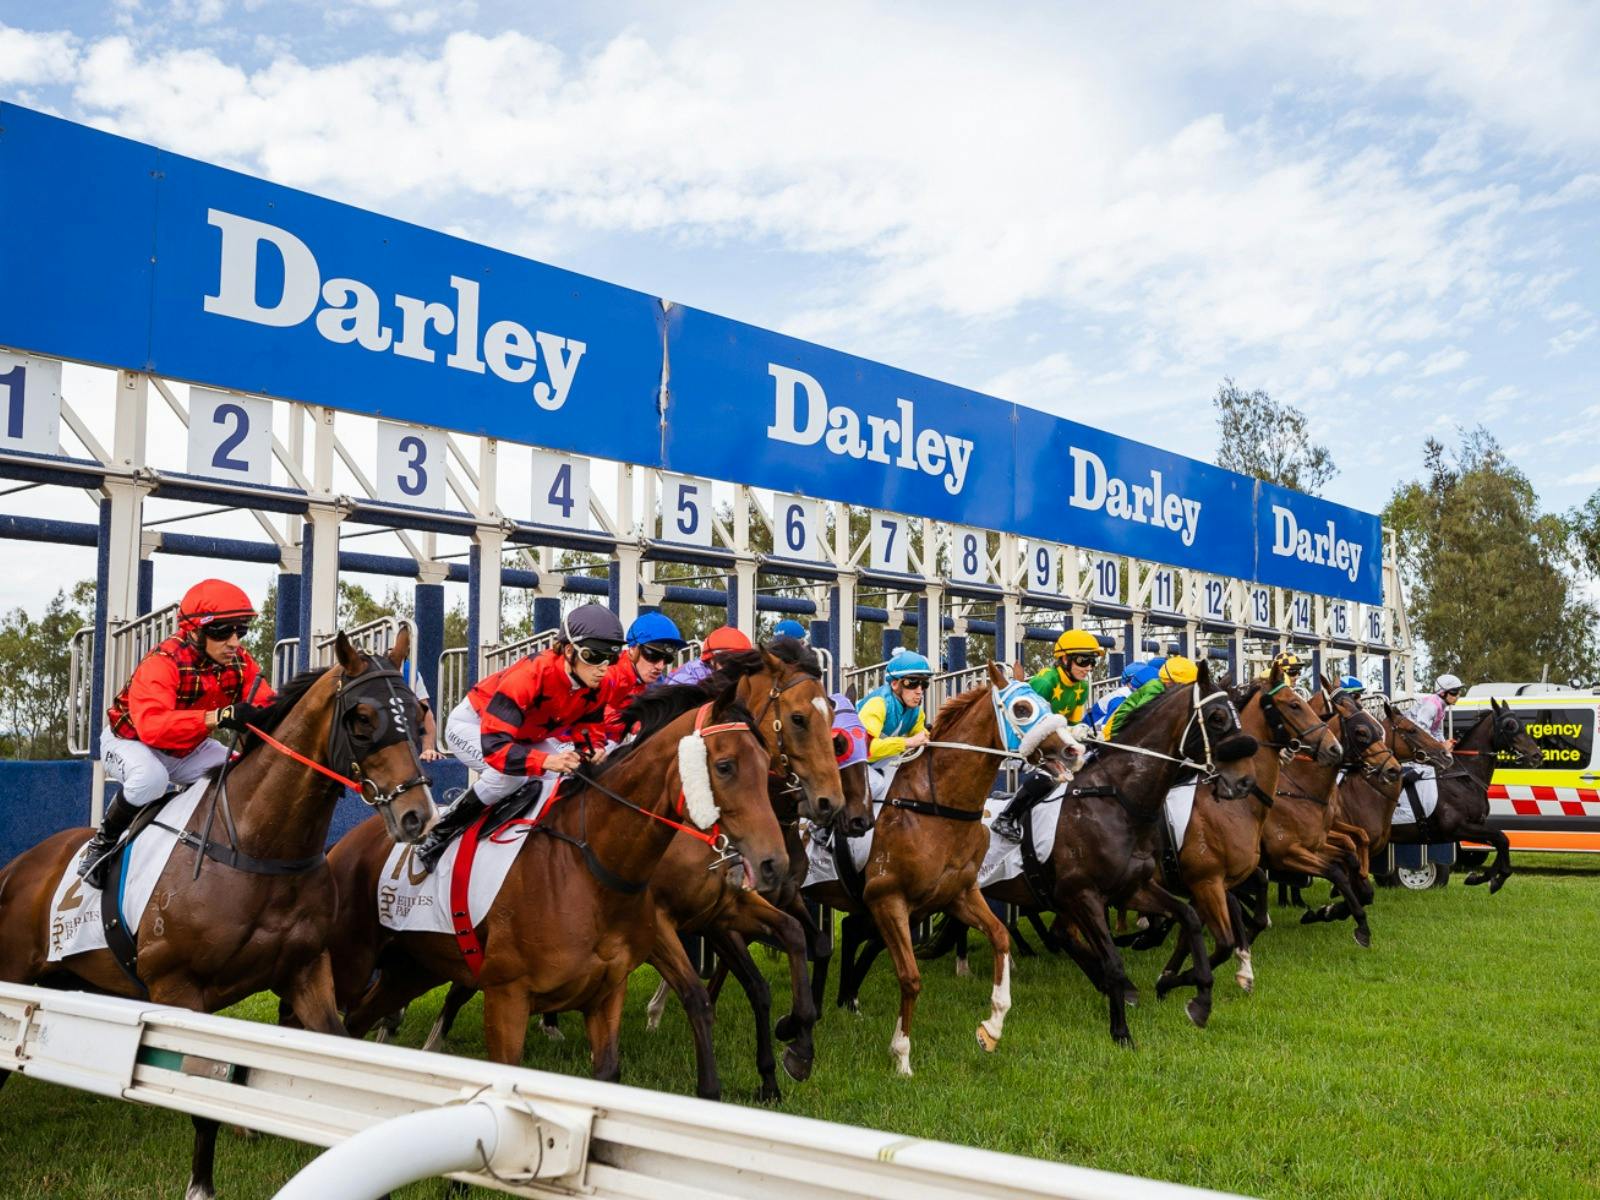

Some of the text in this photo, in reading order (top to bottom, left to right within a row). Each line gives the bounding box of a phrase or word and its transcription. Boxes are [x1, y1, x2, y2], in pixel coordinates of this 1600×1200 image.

[204, 208, 587, 411] Darley
[0, 366, 26, 439] 1
[212, 402, 250, 472] 2
[767, 362, 974, 496] Darley
[398, 436, 428, 496] 3
[548, 464, 575, 519] 4
[677, 485, 699, 536] 5
[1069, 446, 1202, 547] Darley
[786, 505, 806, 552] 6
[881, 519, 898, 563] 7
[1272, 504, 1363, 583] Darley
[963, 535, 979, 576] 8
[1036, 547, 1050, 587] 9
[1096, 560, 1117, 598] 10
[1155, 572, 1171, 607] 11
[1205, 580, 1222, 616] 12
[1252, 589, 1269, 623] 13
[1294, 597, 1309, 627] 14
[1333, 605, 1346, 634] 15
[1368, 610, 1382, 639] 16
[1526, 723, 1582, 738] rgency
